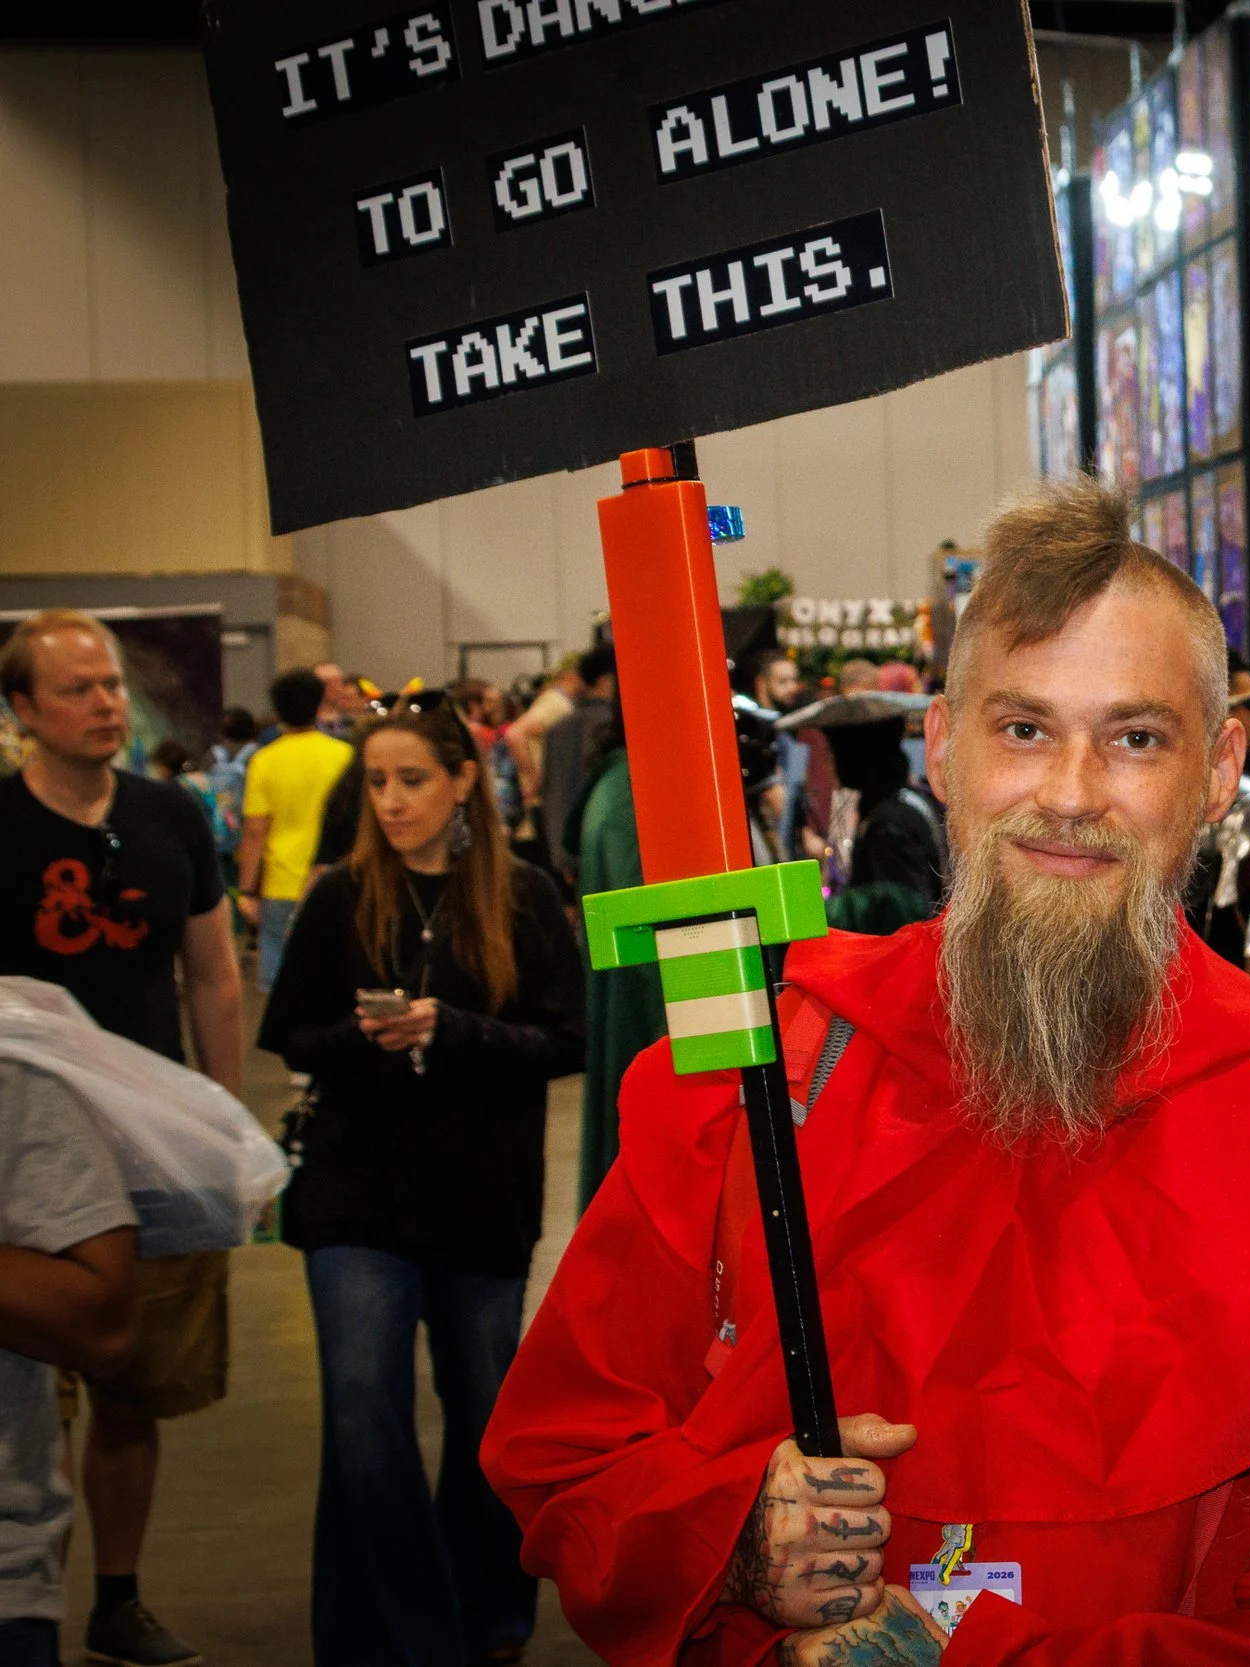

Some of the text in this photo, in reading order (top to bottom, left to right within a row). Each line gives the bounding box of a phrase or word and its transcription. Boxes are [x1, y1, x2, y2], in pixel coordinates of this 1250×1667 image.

[276, 15, 450, 116] IT'S
[358, 31, 952, 253] TO GO ALONE!
[410, 236, 886, 402] TAKE THIS.
[987, 1571, 1015, 1580] 2026
